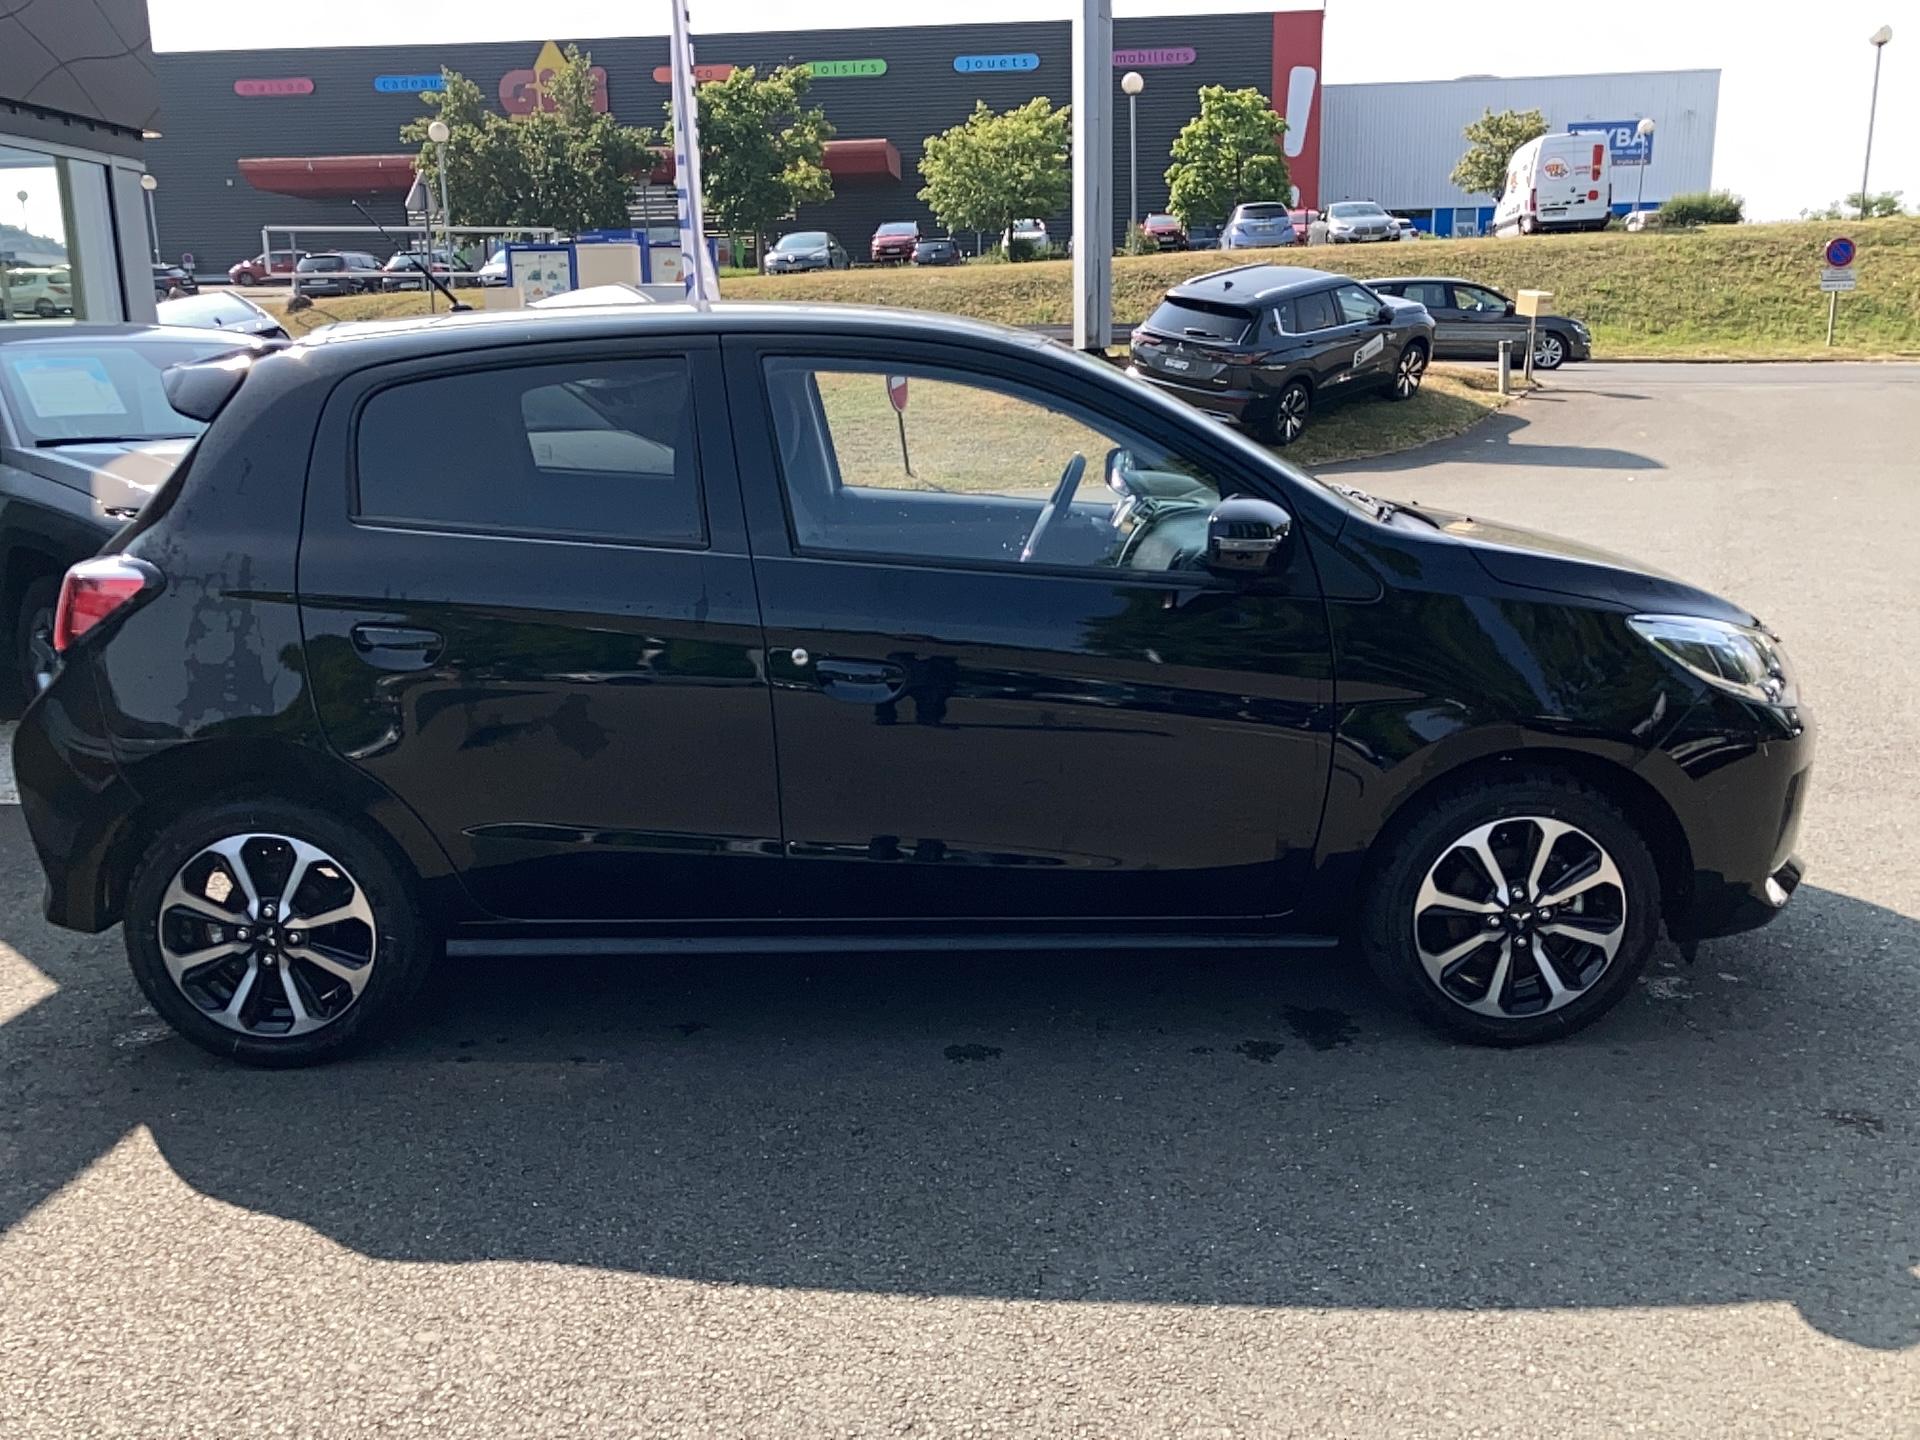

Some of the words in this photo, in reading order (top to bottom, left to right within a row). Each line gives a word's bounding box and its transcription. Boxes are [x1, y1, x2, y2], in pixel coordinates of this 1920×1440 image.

[965, 57, 1029, 71] jouets
[1115, 51, 1190, 64] mobiliers
[811, 59, 878, 75] loisirs
